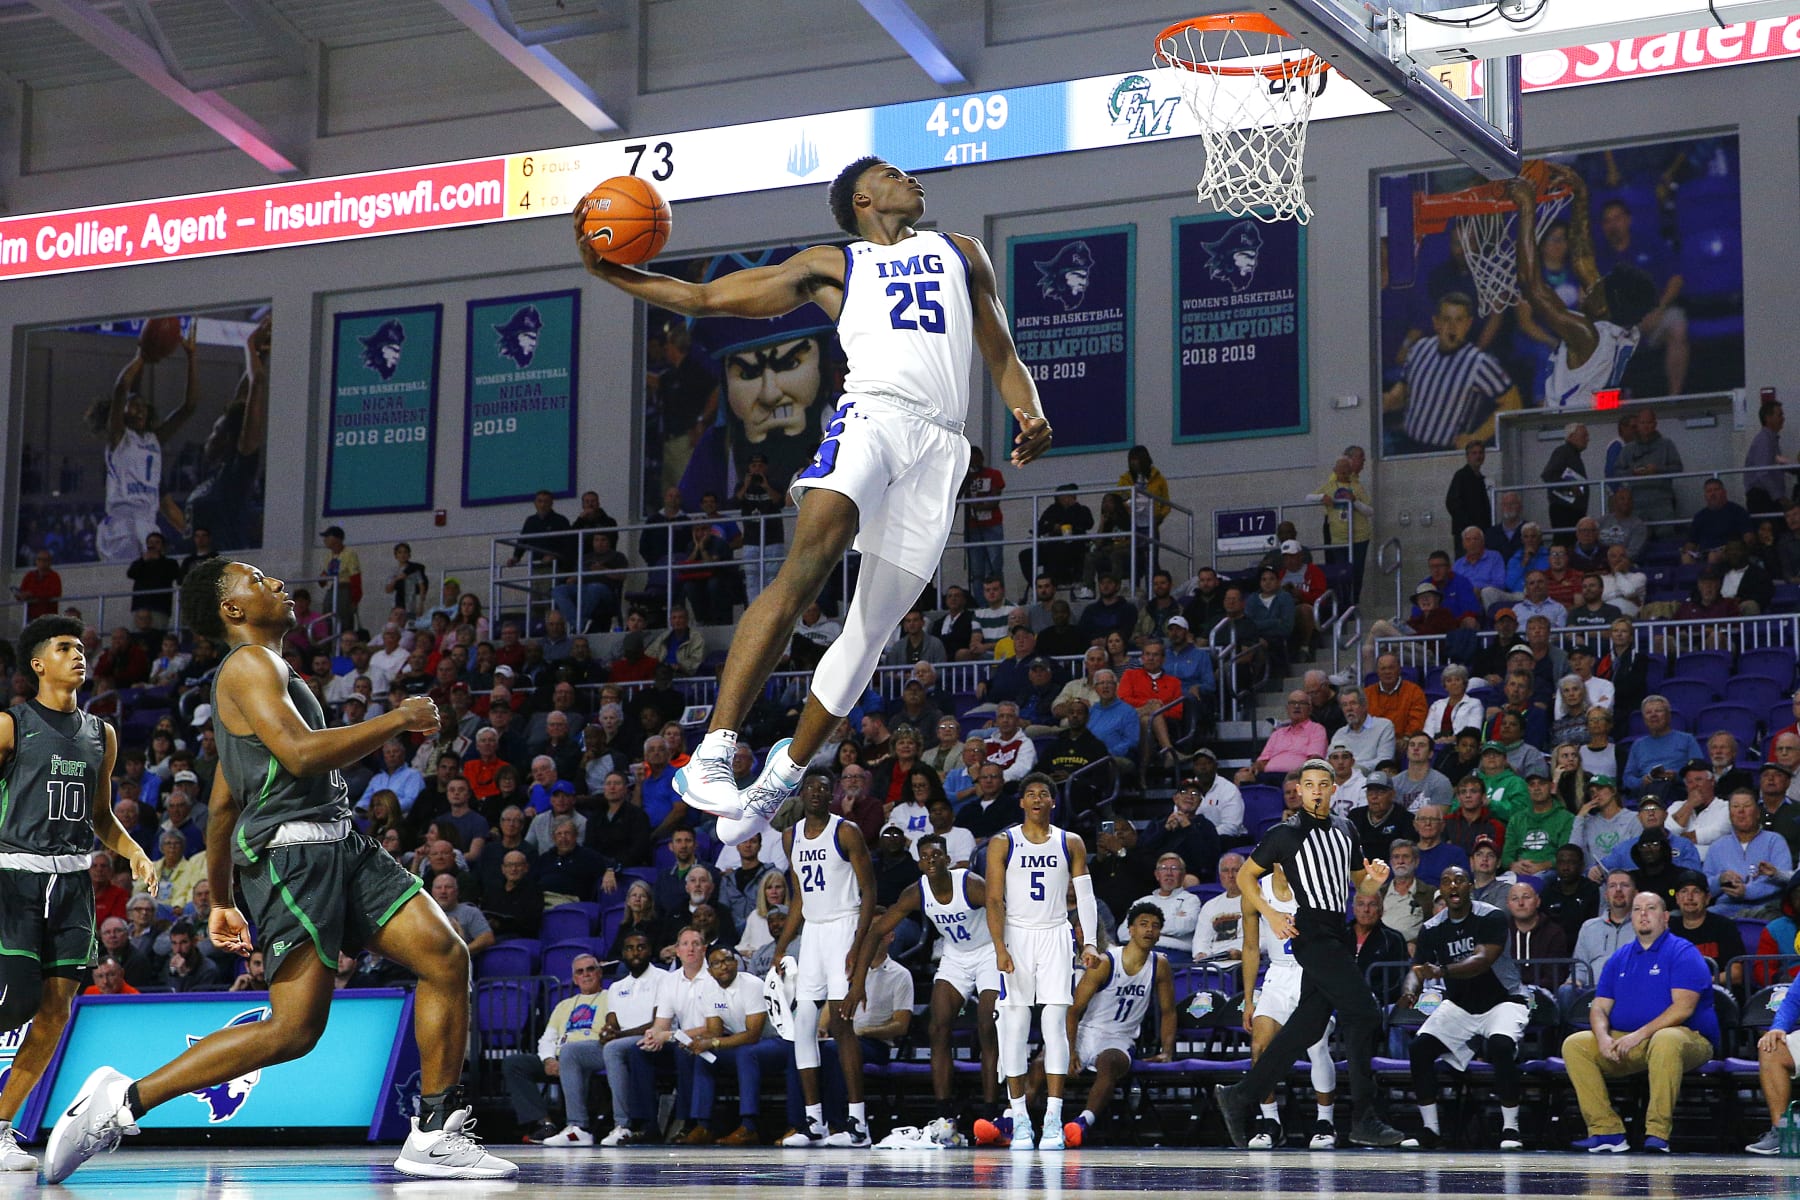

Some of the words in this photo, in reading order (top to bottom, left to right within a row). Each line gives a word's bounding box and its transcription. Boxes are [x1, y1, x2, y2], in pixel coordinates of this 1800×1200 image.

[926, 94, 1009, 137] 4:09
[625, 141, 674, 181] 73
[944, 141, 987, 164] 4TH
[522, 157, 534, 177] 6
[519, 191, 531, 210] 4
[35, 220, 134, 260] Collier,
[140, 206, 227, 254] Agent
[264, 179, 501, 232] insuringswfl.com
[875, 254, 944, 278] IMG
[885, 281, 945, 334] 25
[1182, 296, 1228, 309] WOMEN'S
[1230, 288, 1294, 306] BASKETBALL
[1017, 315, 1050, 328] MEN'S
[1052, 308, 1123, 324] BASKETBALL
[1182, 314, 1295, 345] CHAMPIONS
[1016, 333, 1124, 361] CHAMPIONS
[1182, 348, 1217, 366] 2018
[1222, 344, 1256, 363] 2019
[515, 368, 568, 381] BASKETBALL
[1053, 362, 1086, 380] 2019
[369, 381, 427, 395] BASKETBALL
[474, 396, 568, 417] TOURNAMENT
[336, 407, 428, 427] TOURNAMENT
[473, 418, 517, 436] 2019
[335, 430, 378, 447] 2018
[384, 427, 426, 443] 2019
[1239, 516, 1265, 531] 117
[51, 760, 87, 776] FORT
[47, 781, 86, 821] 10
[799, 849, 826, 862] IMG
[1020, 855, 1058, 868] IMG
[801, 864, 826, 892] 24
[1030, 872, 1045, 901] 5
[934, 911, 967, 924] IMG
[945, 925, 971, 944] 14
[1447, 937, 1474, 956] IMG
[1115, 984, 1146, 998] IMG
[1114, 999, 1133, 1023] 11
